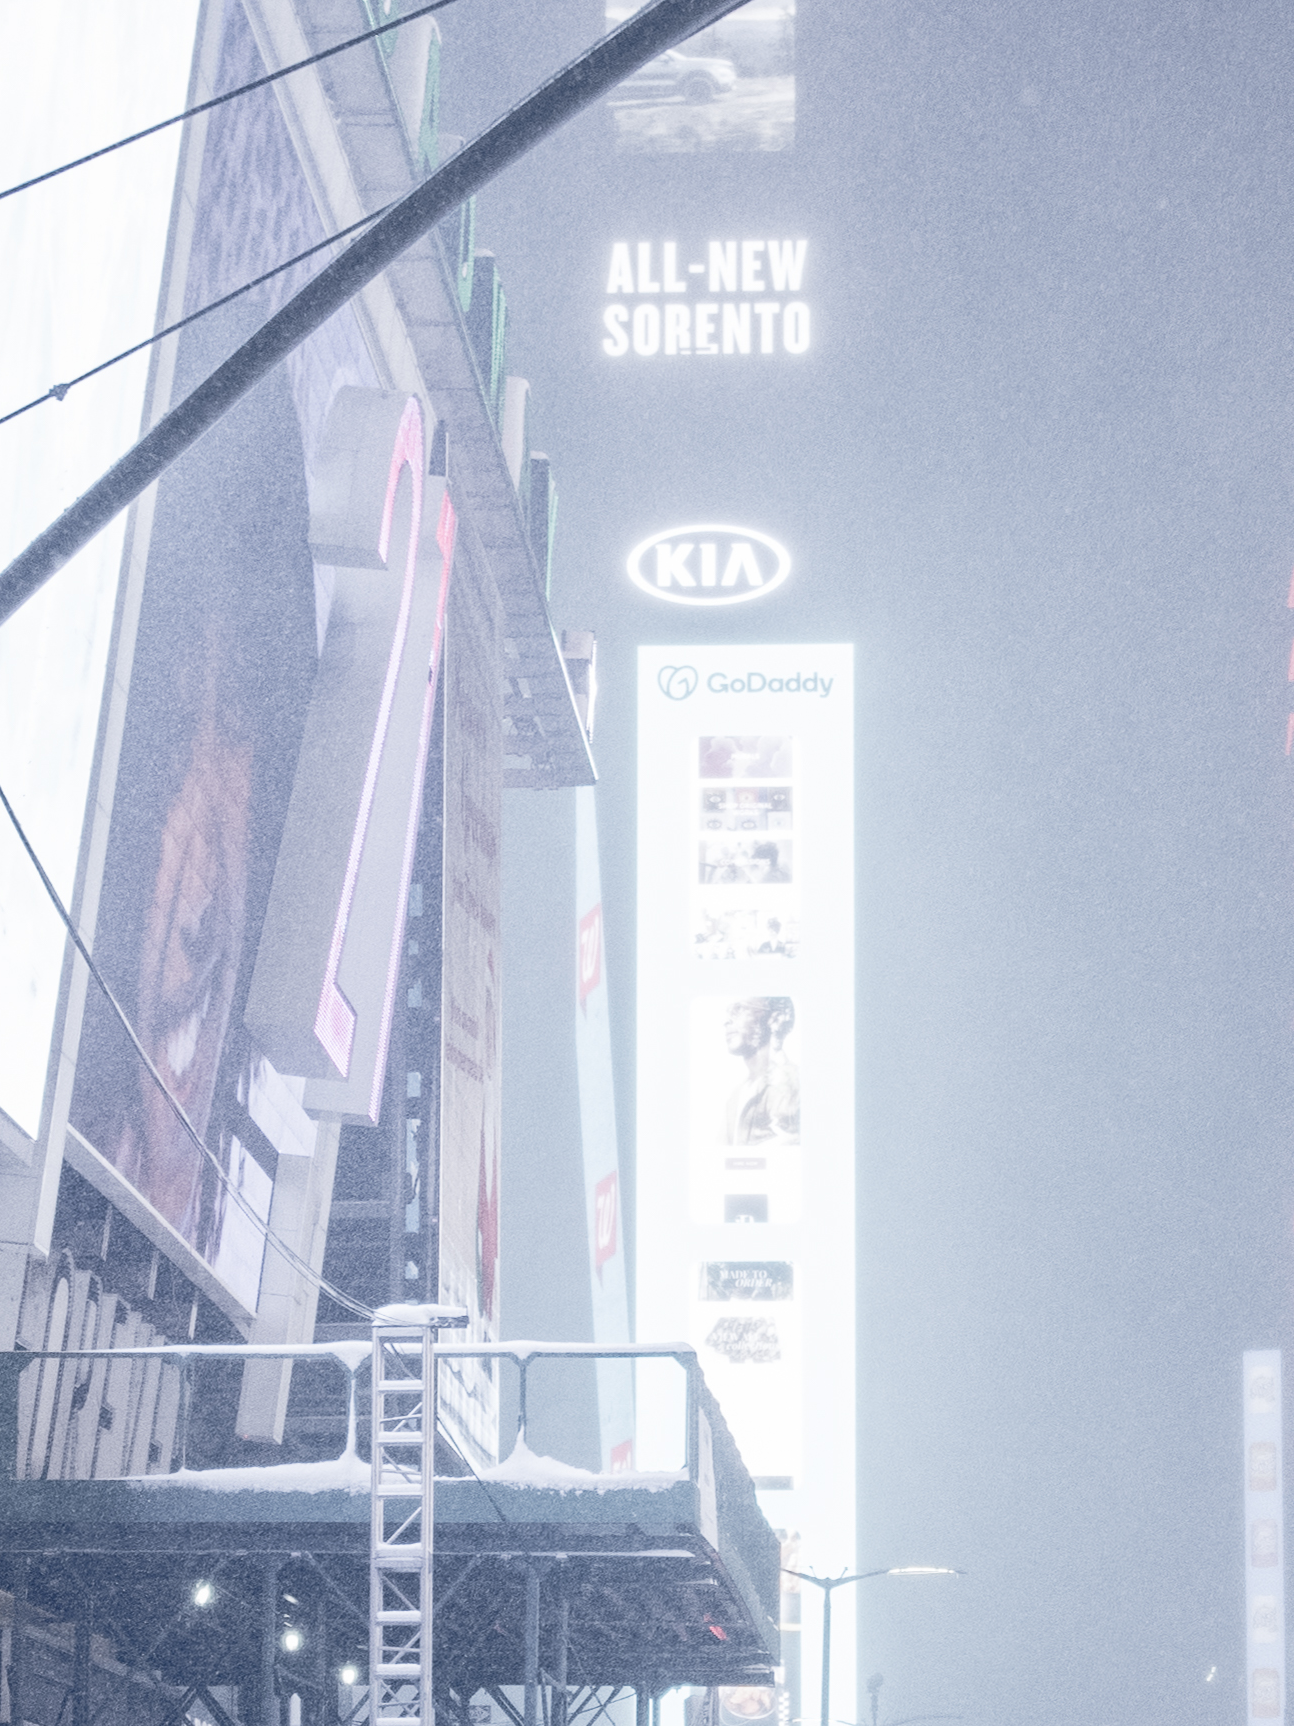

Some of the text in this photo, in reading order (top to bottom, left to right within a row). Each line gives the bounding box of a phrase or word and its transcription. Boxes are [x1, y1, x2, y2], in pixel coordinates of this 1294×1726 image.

[607, 240, 807, 294] ALL-NEW
[603, 301, 811, 357] SORENTO
[655, 542, 764, 588] KIA
[706, 671, 835, 699] GoDaddy
